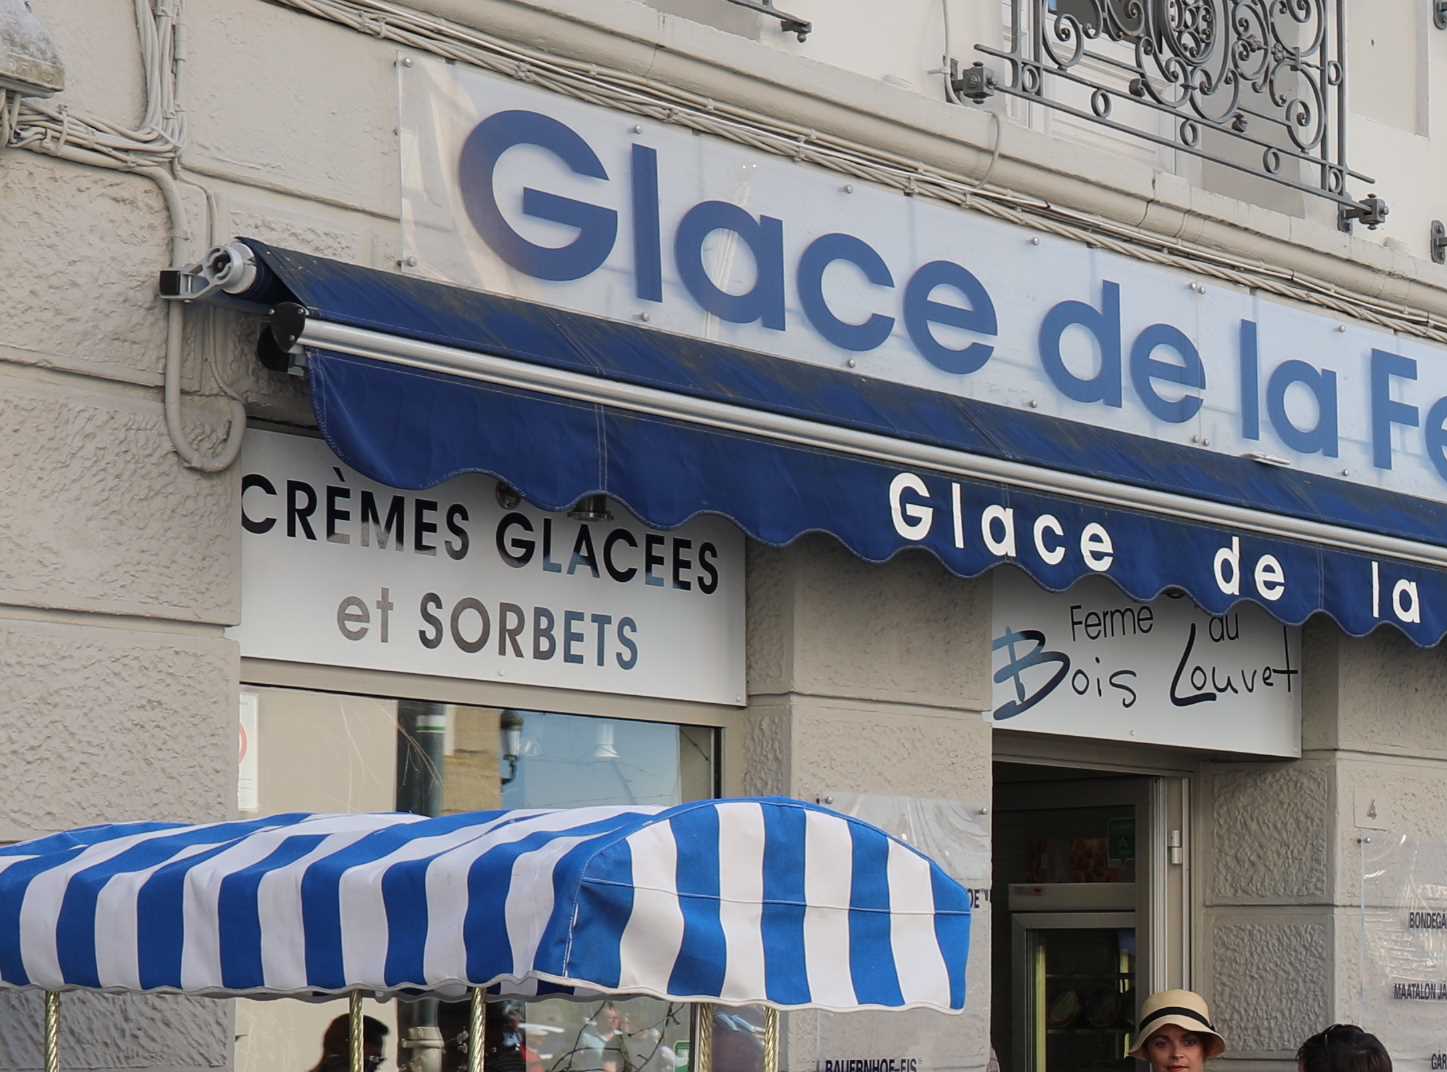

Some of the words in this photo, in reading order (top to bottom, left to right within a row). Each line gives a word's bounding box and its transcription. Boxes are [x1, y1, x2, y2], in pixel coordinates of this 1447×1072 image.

[459, 109, 997, 376] Glace
[1039, 280, 1206, 425] de
[1240, 319, 1338, 457] la
[241, 467, 470, 560] CRÈMES
[889, 472, 1114, 572] Glace
[1214, 536, 1286, 603] de
[1371, 562, 1420, 625] la
[336, 587, 393, 643] et
[418, 592, 640, 670] SORBETS
[1070, 605, 1154, 641] Ferme
[992, 625, 1137, 721] Bois
[1170, 620, 1298, 707] Louvet
[1393, 983, 1436, 1000] MAATALON
